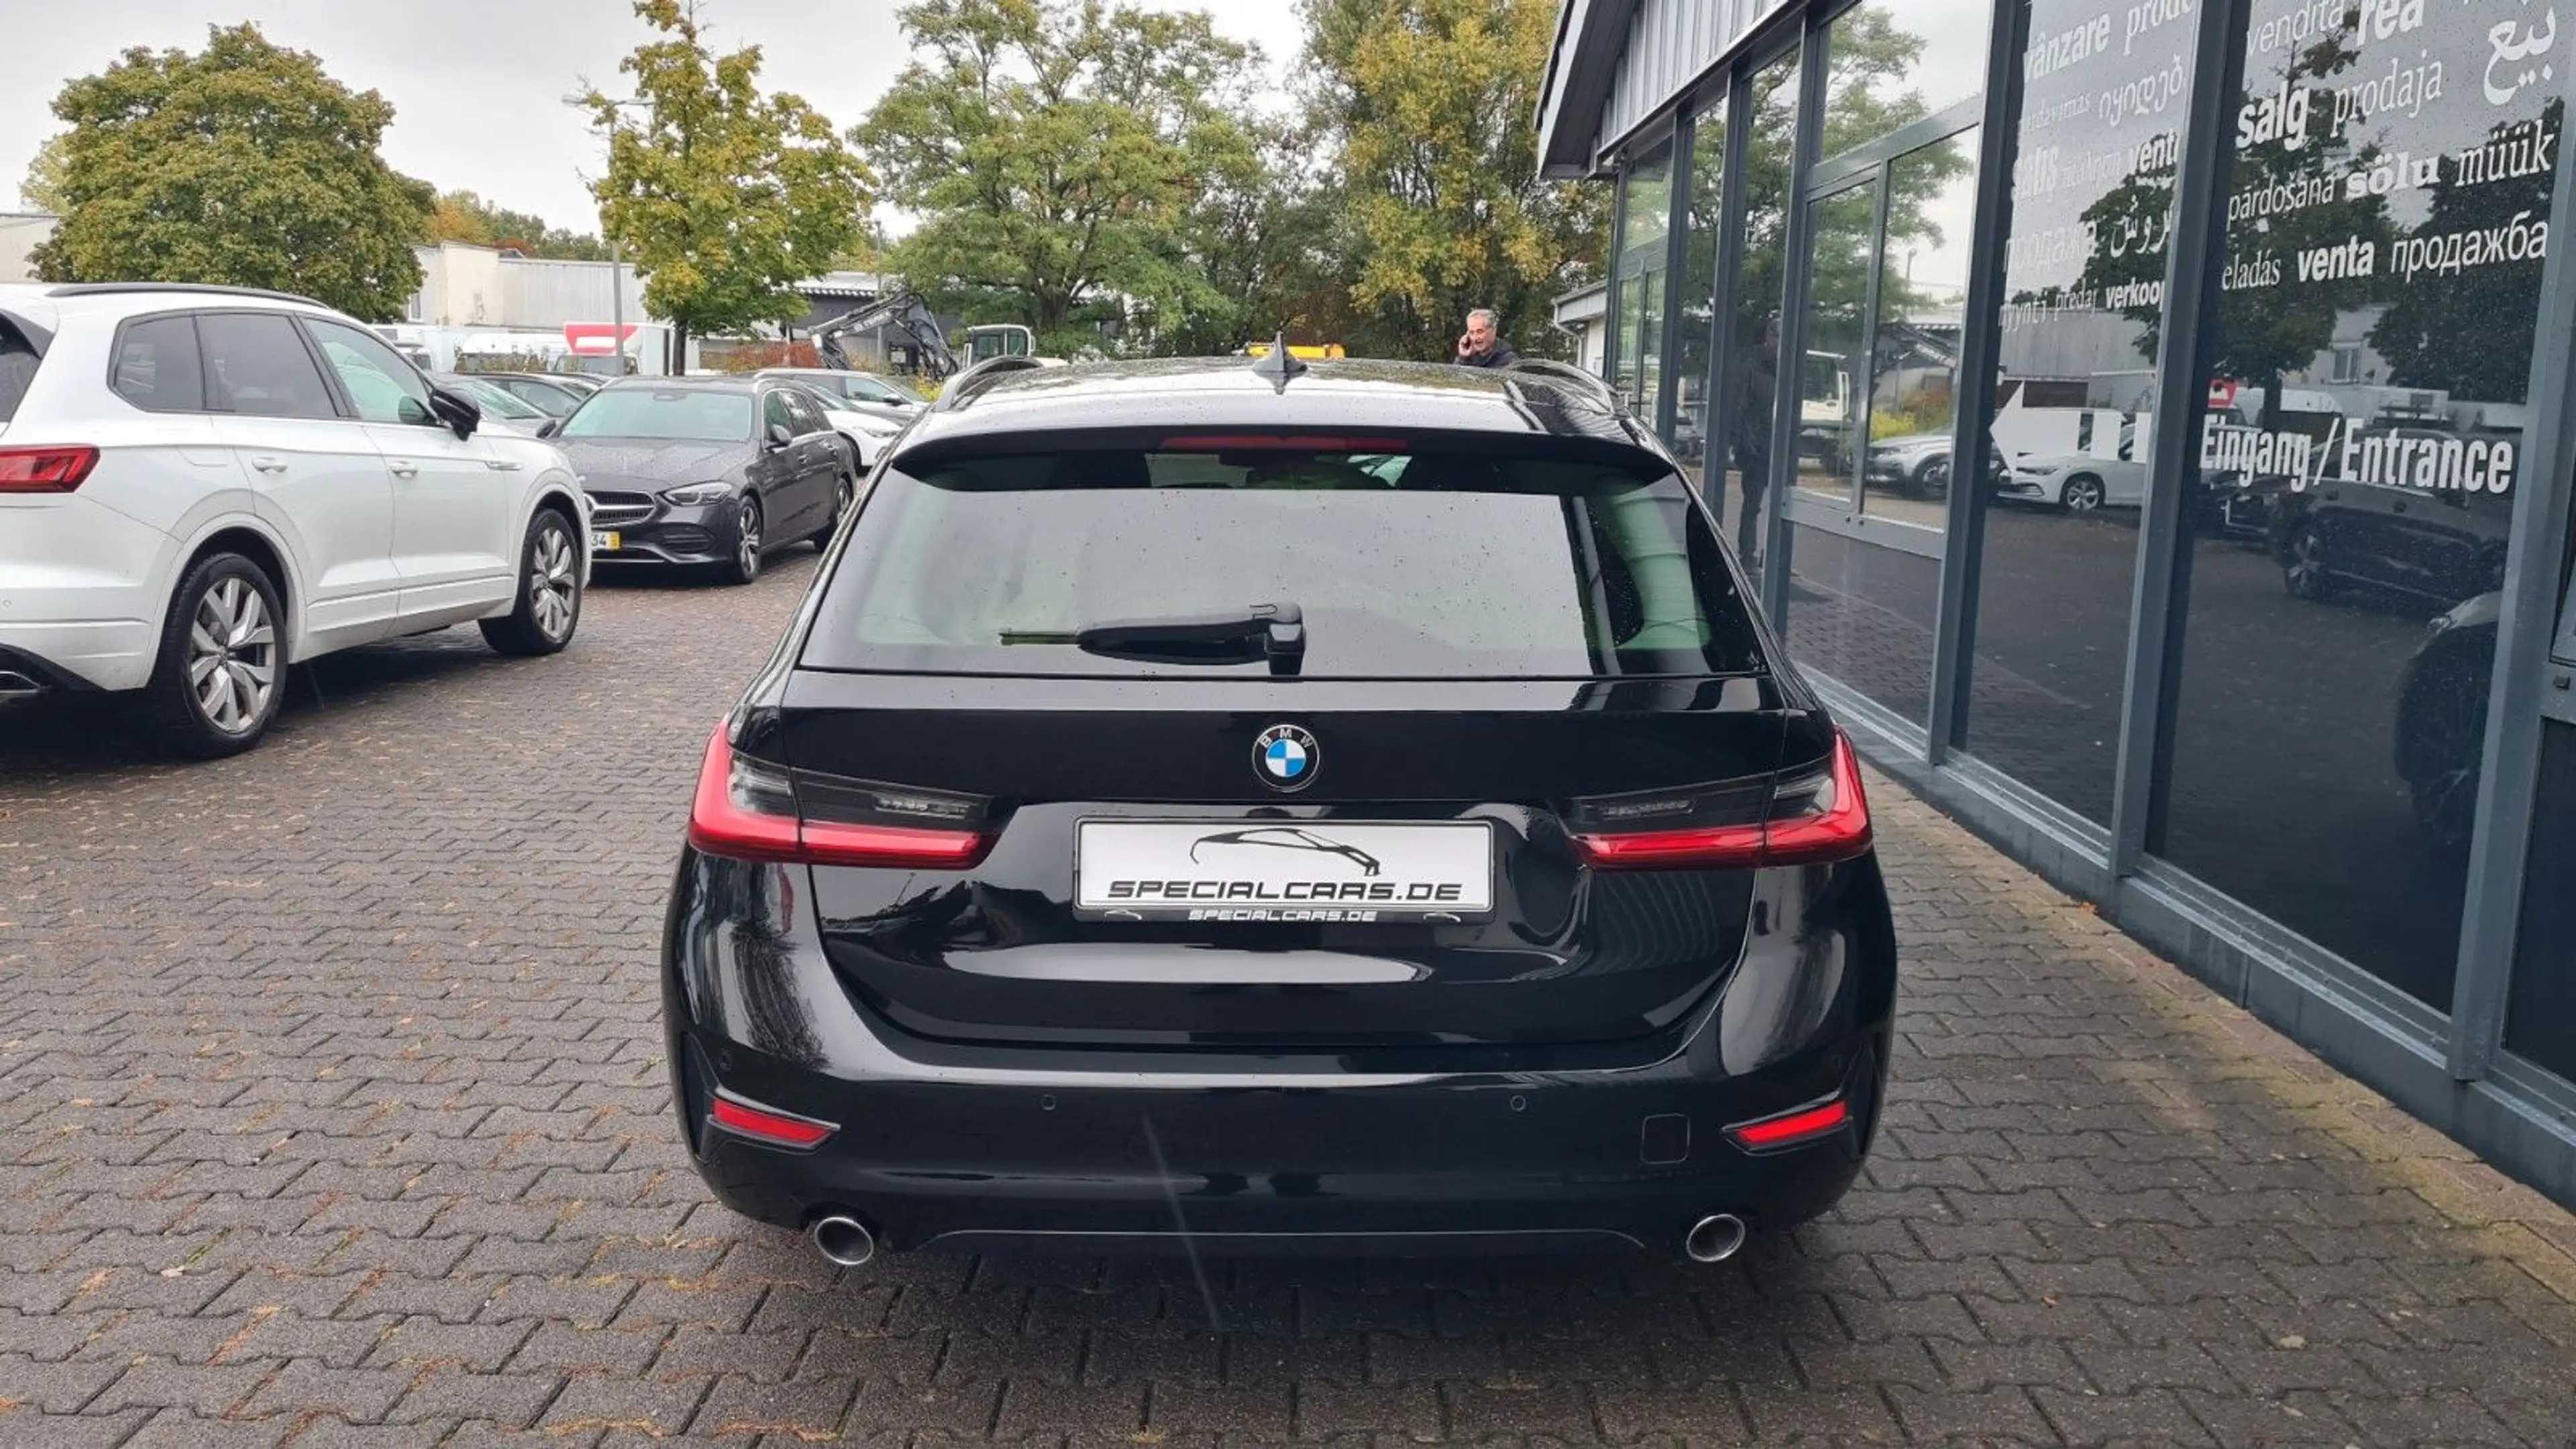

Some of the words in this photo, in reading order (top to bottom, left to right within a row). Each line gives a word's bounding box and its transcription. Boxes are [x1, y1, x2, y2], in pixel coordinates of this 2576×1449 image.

[2247, 0, 2344, 56] vendita
[2483, 7, 2556, 105] بيع
[2236, 81, 2309, 150] salg
[2330, 49, 2442, 138] prodaja
[2226, 171, 2336, 232] pārdošana
[2347, 150, 2440, 200] sölu
[2455, 119, 2554, 187] müük
[2222, 250, 2280, 290] eladás
[2298, 235, 2374, 282] venta
[2390, 210, 2549, 282] продажба
[1258, 728, 1313, 749] BMW
[1107, 880, 1463, 901] SPECIALCARS.DE
[1187, 909, 1378, 922] SPECIALCARS.DE
